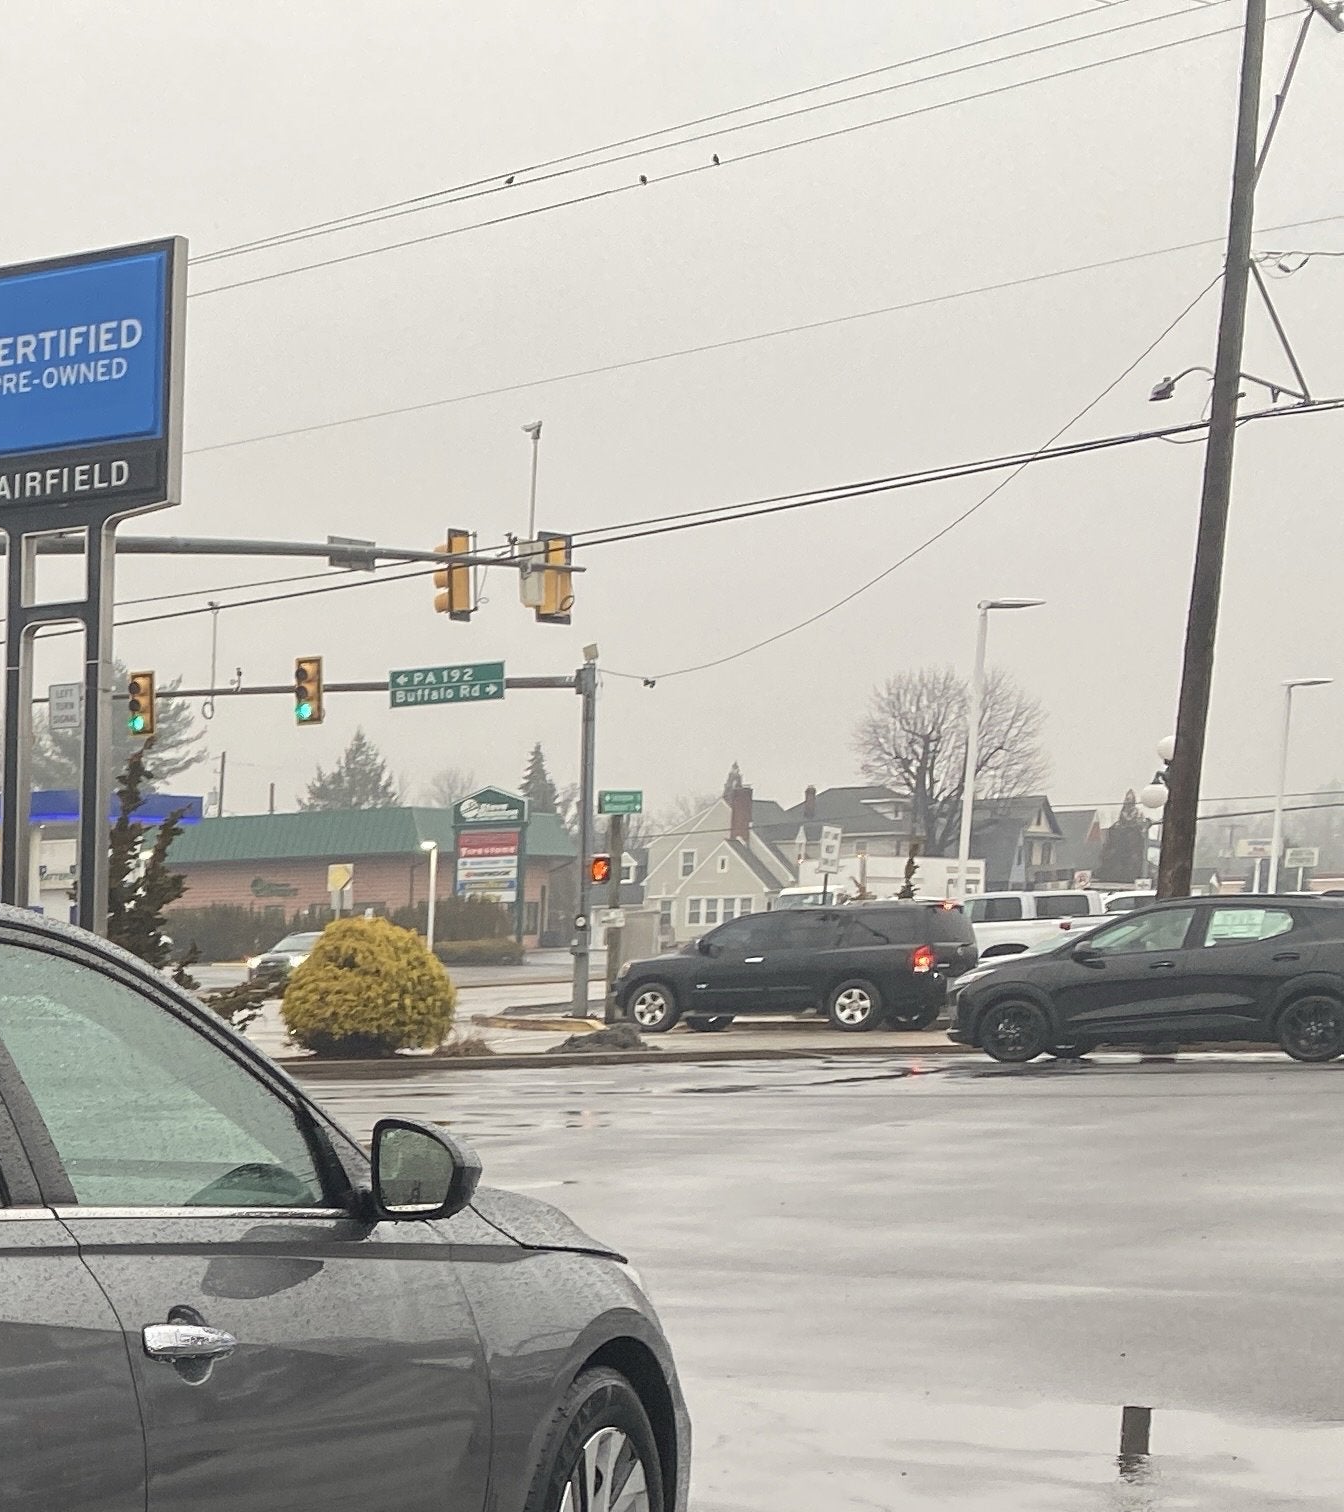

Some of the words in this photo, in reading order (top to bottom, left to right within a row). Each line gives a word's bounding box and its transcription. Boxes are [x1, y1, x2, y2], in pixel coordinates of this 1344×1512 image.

[413, 671, 436, 685] PA
[442, 668, 474, 683] 192
[395, 687, 454, 703] Buffalo
[459, 684, 481, 698] Rd
